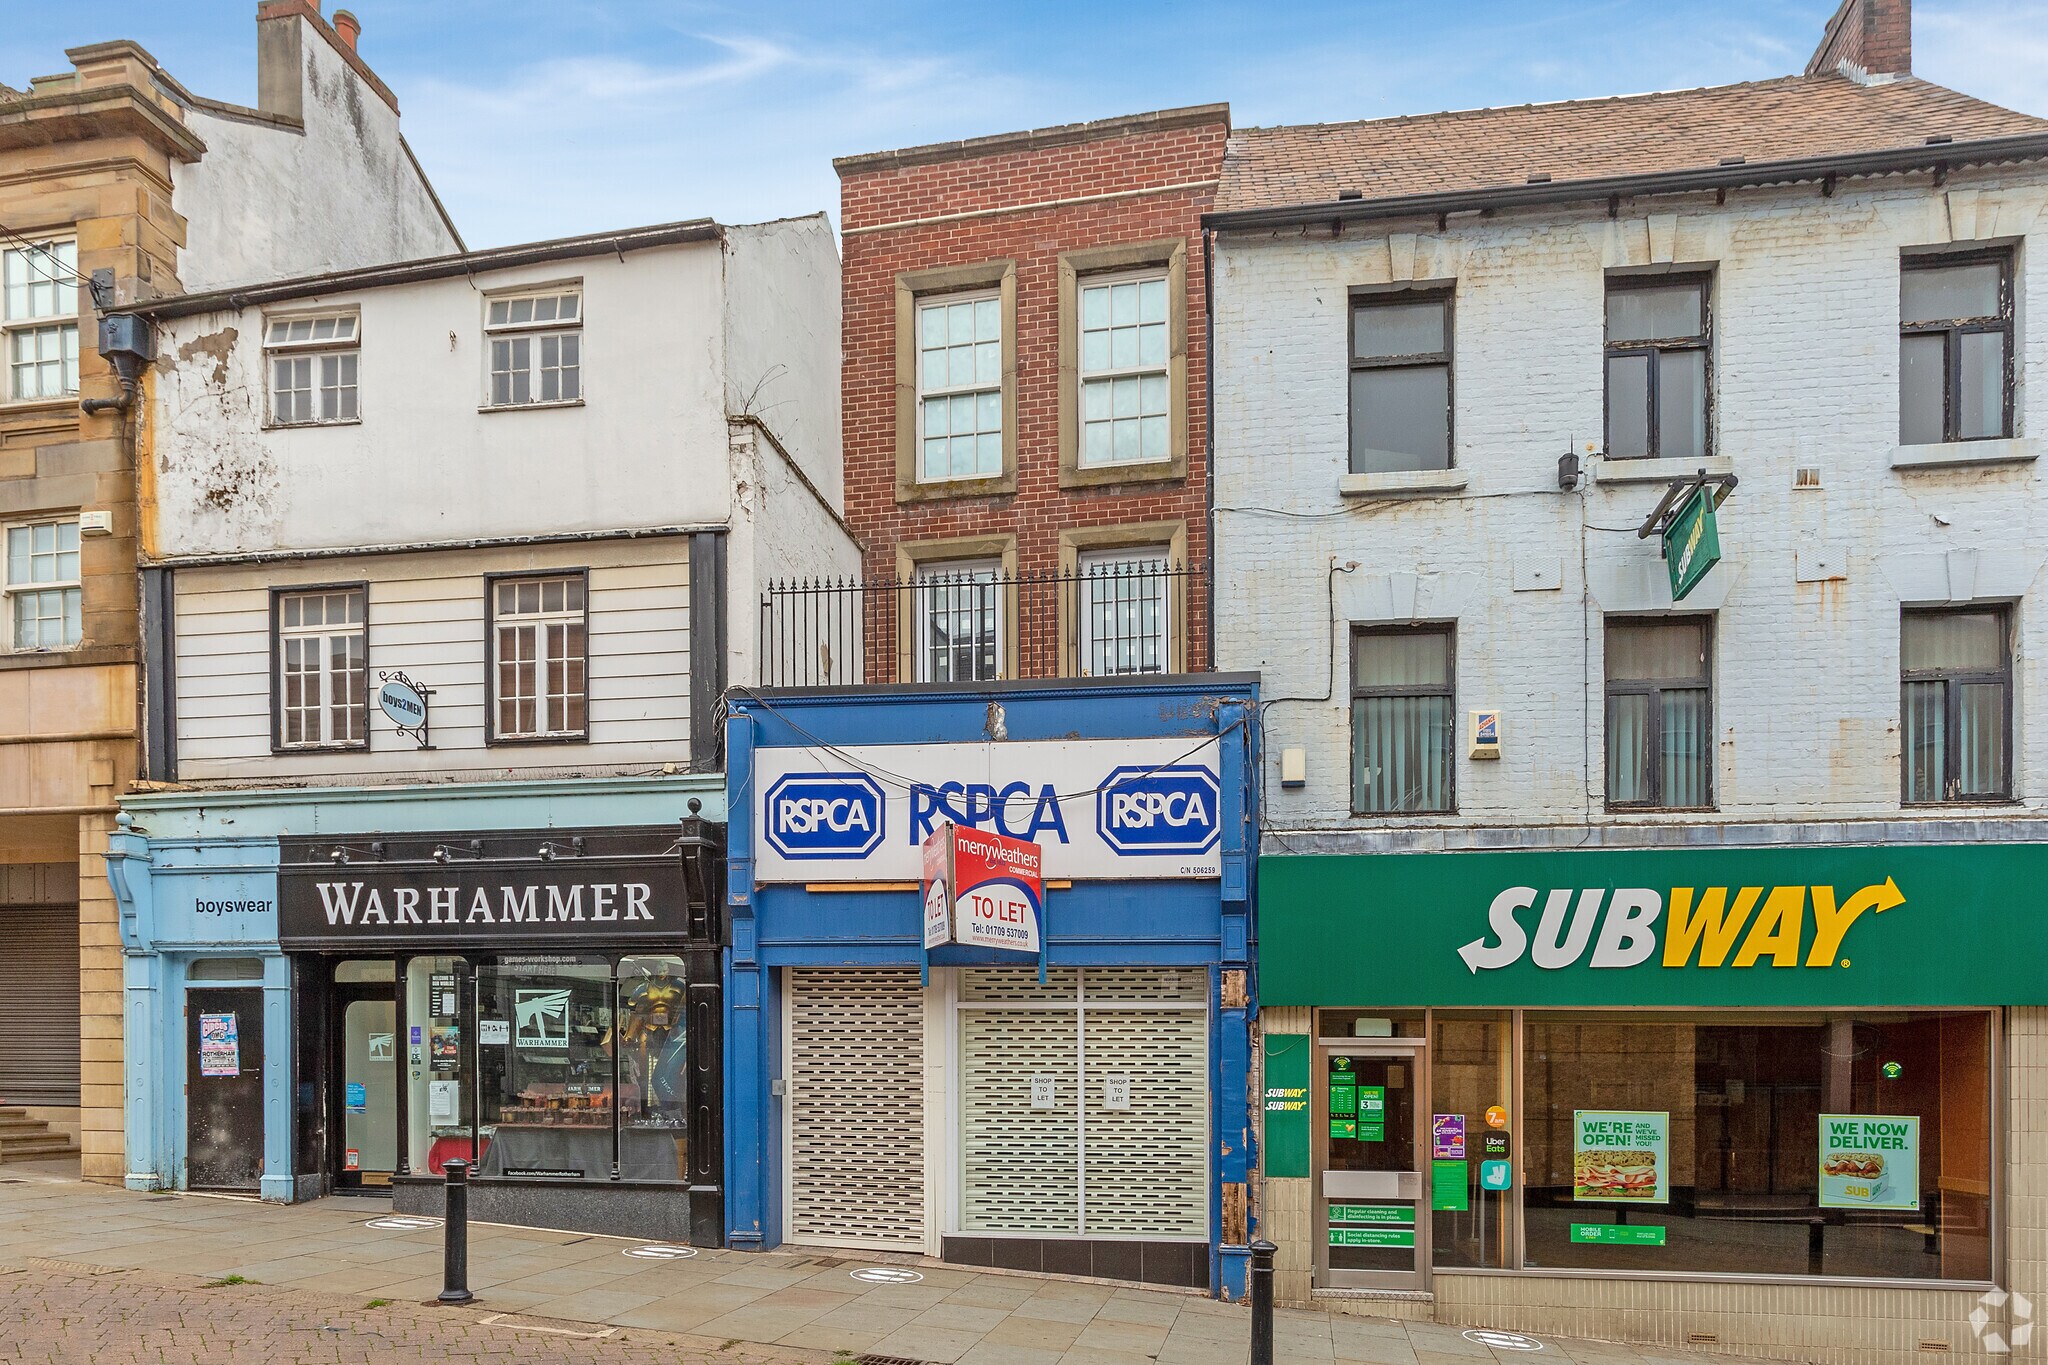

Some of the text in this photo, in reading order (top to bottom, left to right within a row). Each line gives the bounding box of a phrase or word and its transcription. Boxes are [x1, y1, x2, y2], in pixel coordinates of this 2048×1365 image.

[1678, 506, 1704, 584] SUBWAY
[383, 691, 421, 716] boys2MEN
[780, 798, 870, 833] RSPCA
[910, 781, 1070, 845] RSPCA
[1112, 792, 1209, 828] RSPCA
[958, 838, 1038, 869] merryweathers
[1009, 866, 1038, 878] COMMERCIAL
[1181, 866, 1216, 874] C/N 506259
[196, 898, 272, 916] boyswear
[316, 882, 654, 925] WARHAMMER
[934, 894, 943, 918] LET
[972, 896, 1026, 923] TO LET
[972, 923, 1028, 939] Tel: 01709 537009
[1457, 876, 1906, 975] SUBWAY
[504, 955, 576, 964] games-workshop.com
[1265, 1088, 1307, 1097] SUBWAY
[1265, 1101, 1307, 1110] SUBWAY
[1583, 1122, 1632, 1133] WE'RE
[1830, 1122, 1908, 1136] WE NOW
[1583, 1134, 1631, 1146] OPEN!
[1830, 1136, 1908, 1150] DELIVER.
[1844, 1186, 1869, 1197] SUB
